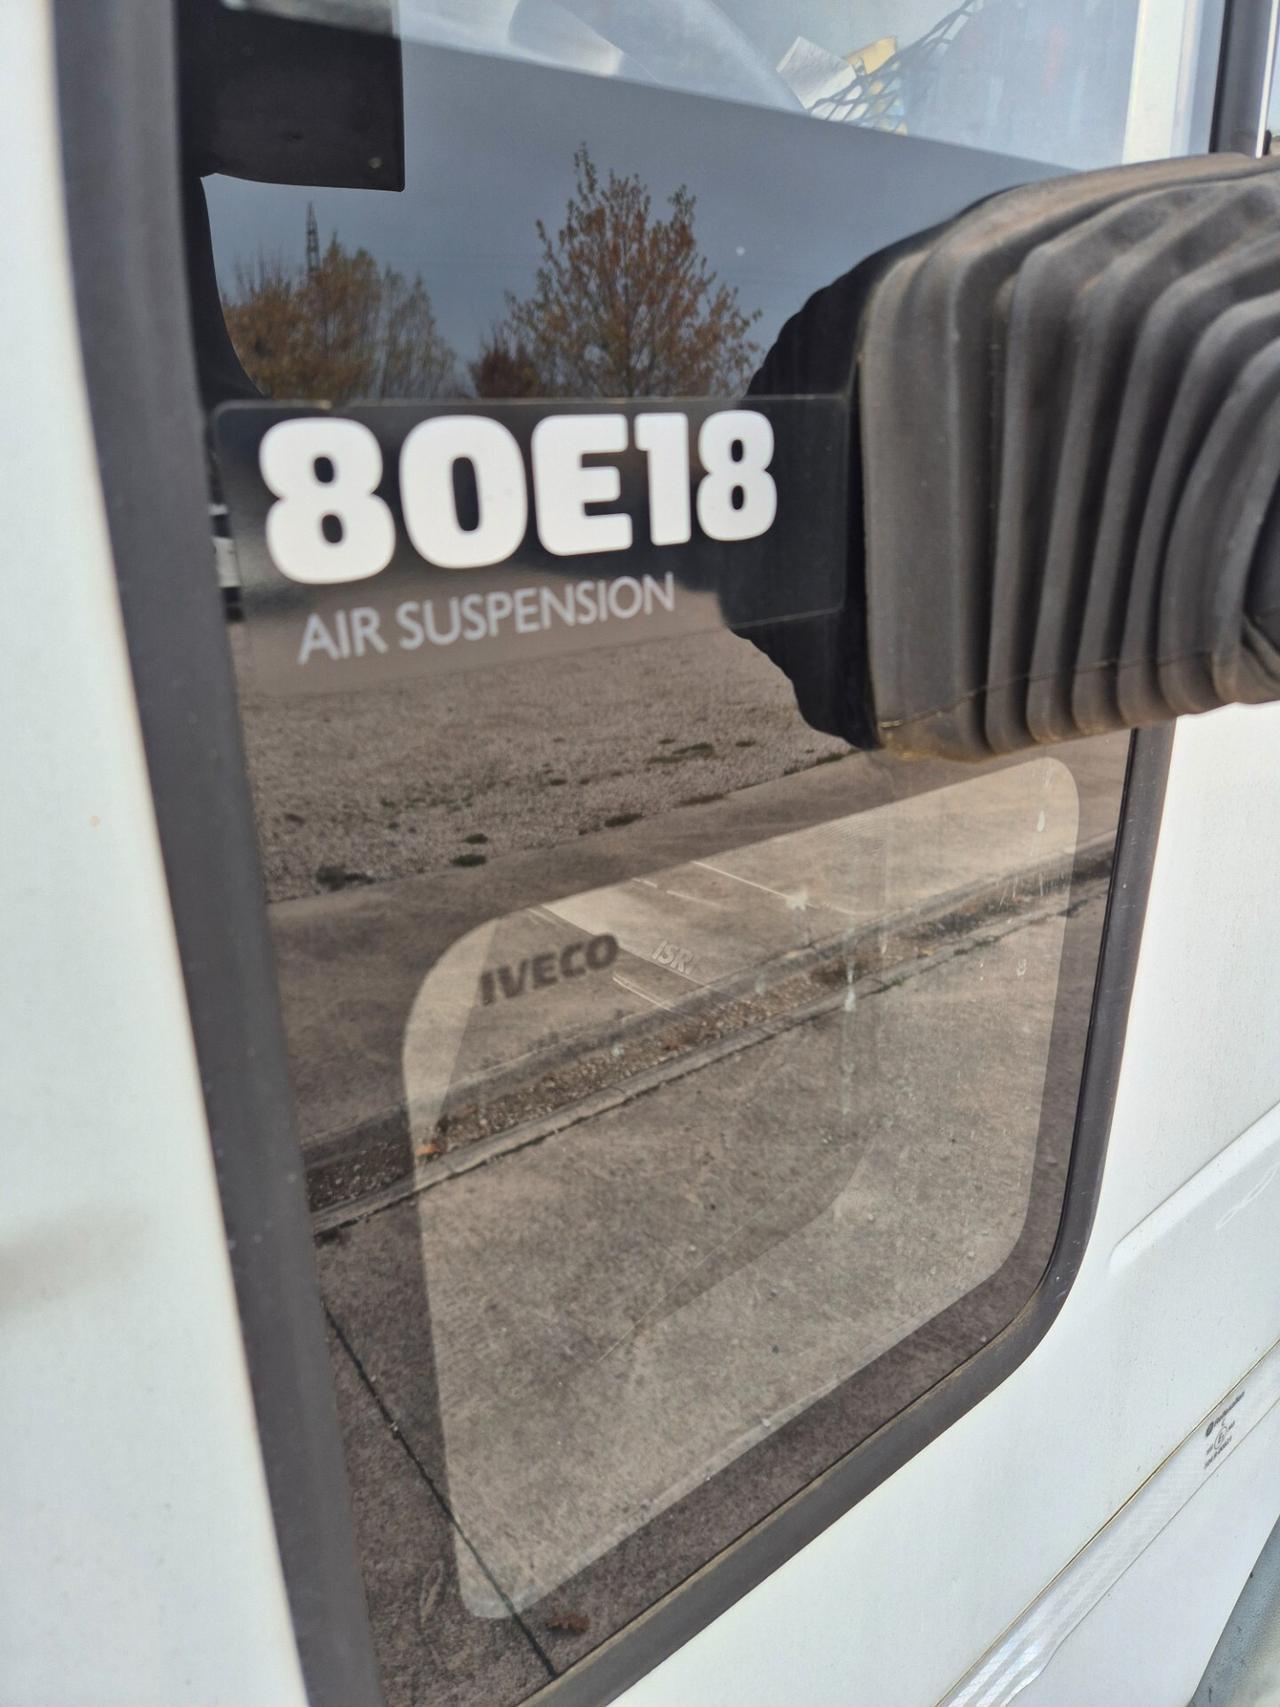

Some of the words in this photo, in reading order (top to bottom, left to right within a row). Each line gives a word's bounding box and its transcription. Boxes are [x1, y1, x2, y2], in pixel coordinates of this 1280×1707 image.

[259, 409, 777, 584] 80E18
[299, 608, 387, 664] AIR
[398, 572, 675, 650] SUSPENSION
[480, 933, 618, 1006] IVECO
